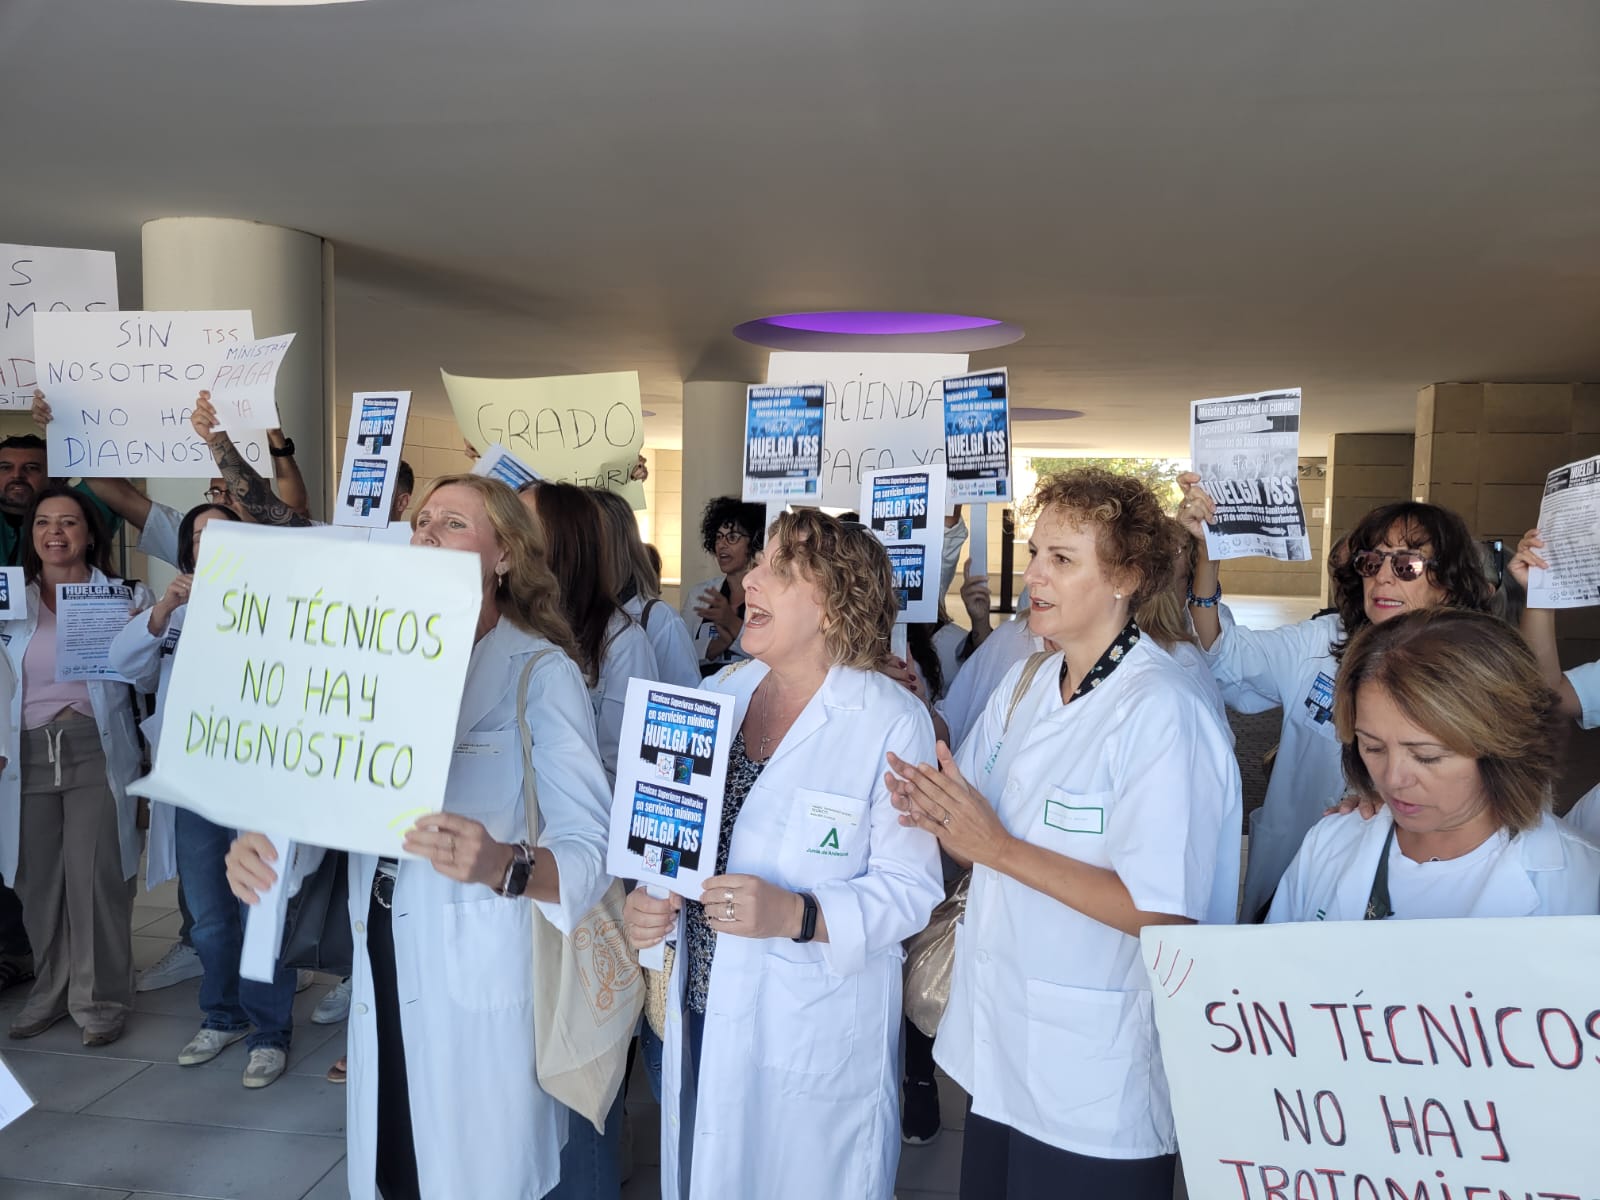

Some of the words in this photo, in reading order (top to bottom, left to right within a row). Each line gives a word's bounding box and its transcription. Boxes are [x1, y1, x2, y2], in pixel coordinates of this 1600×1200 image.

[117, 316, 172, 349] SIN
[202, 328, 239, 345] TSS
[226, 341, 288, 360] MINISTRA
[49, 359, 205, 385] NOSOTRO
[212, 361, 274, 391] PAGA
[232, 400, 252, 417] YA
[823, 372, 943, 422] ACIENDA
[82, 408, 128, 426] NO
[162, 407, 192, 426] HA
[382, 420, 393, 435] TSS
[477, 401, 636, 451] GRADO
[64, 432, 260, 468] DIAGNÓSTO
[749, 436, 794, 459] HUELGA
[797, 435, 819, 457] TSS
[947, 431, 984, 457] HUELGA
[985, 430, 1006, 455] TSS
[371, 482, 382, 497] TSS
[1201, 478, 1262, 505] HUELGA
[1262, 476, 1295, 505] TSS
[873, 500, 907, 519] HUELGA
[909, 498, 926, 517] TSS
[65, 586, 110, 595] HUELGA
[905, 571, 921, 588] TSS
[216, 583, 271, 635] SIN
[287, 587, 443, 660] TÉCNICOS
[240, 659, 285, 707] NO
[304, 667, 378, 722] HAY
[648, 710, 656, 720] en
[658, 711, 686, 725] servicios
[687, 714, 715, 729] mínimos
[185, 705, 413, 790] DIAGNÓSTICO
[644, 723, 688, 754] HUELGA
[690, 733, 713, 759] TSS
[636, 800, 644, 811] en
[644, 802, 673, 818] servicios
[674, 807, 702, 823] mínimos
[631, 815, 676, 847] HUELGA
[678, 826, 700, 853] TSS
[1205, 988, 1297, 1058] SIN
[1273, 1087, 1346, 1147] NO
[1380, 1094, 1510, 1163] HAY
